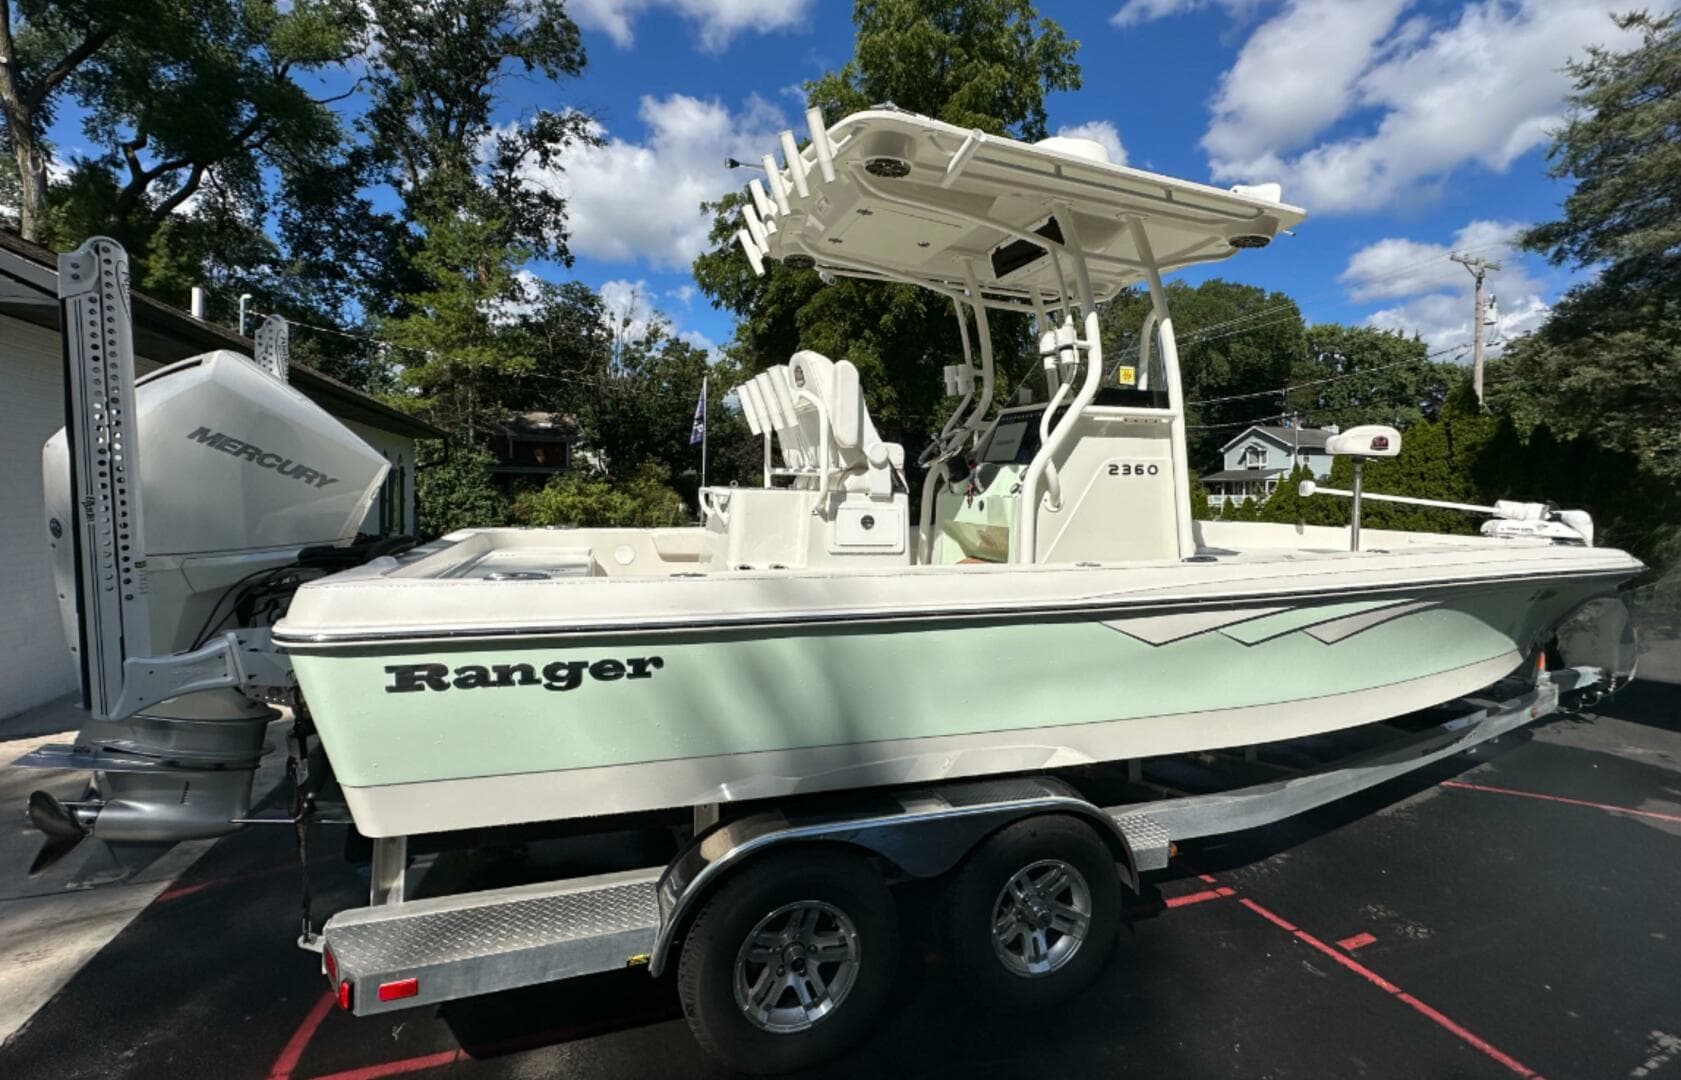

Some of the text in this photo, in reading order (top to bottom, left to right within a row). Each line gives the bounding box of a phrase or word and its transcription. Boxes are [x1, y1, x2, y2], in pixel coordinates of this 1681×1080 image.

[186, 426, 340, 488] MERCURY
[1108, 464, 1158, 475] 2360
[385, 656, 664, 693] Ranger
